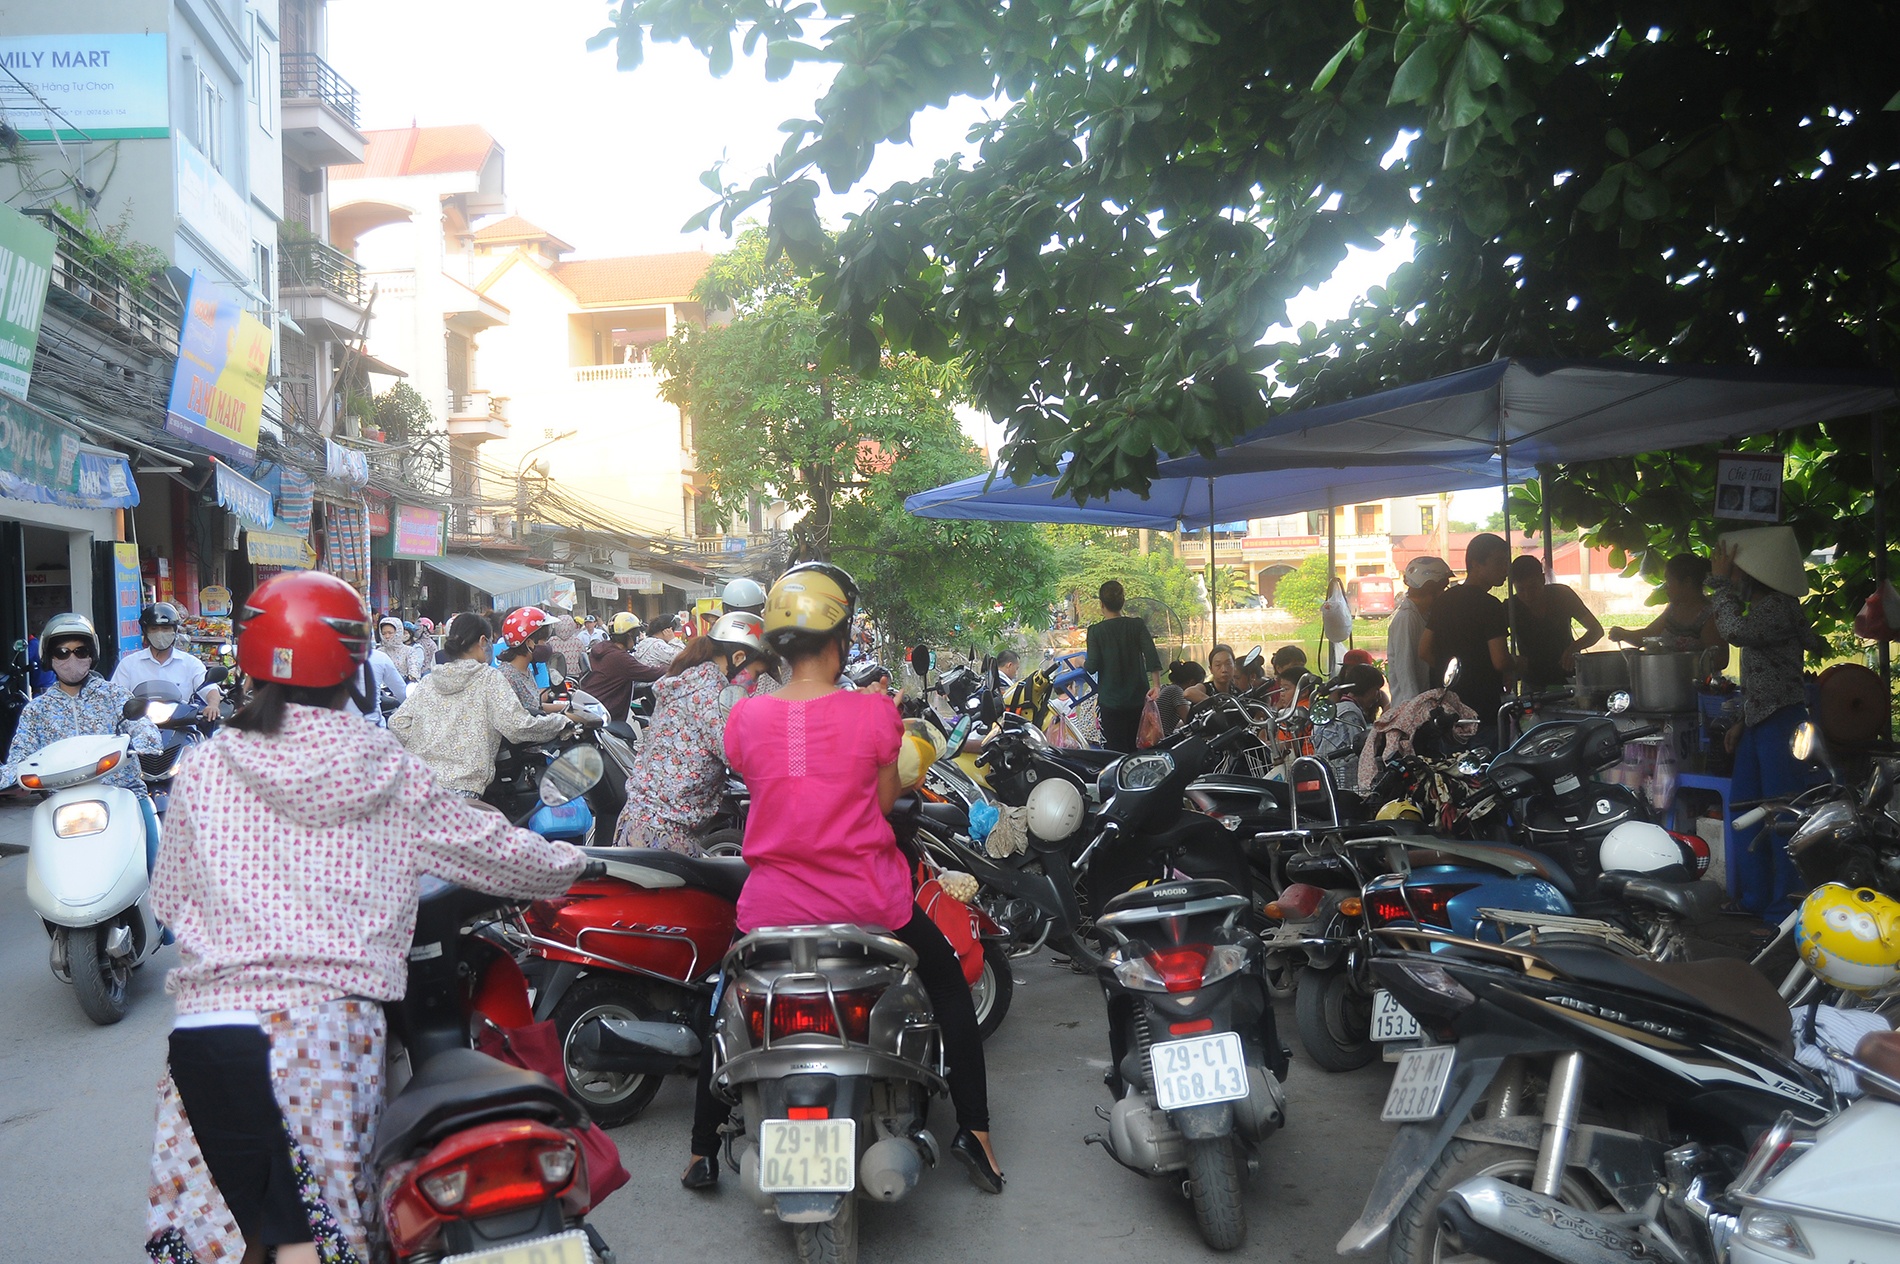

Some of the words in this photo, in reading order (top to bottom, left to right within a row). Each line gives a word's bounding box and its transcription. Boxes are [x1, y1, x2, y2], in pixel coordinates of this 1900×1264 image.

[52, 50, 110, 68] MART
[42, 82, 70, 92] Hàng
[86, 81, 114, 91] Chọn
[187, 374, 217, 420] FAMI
[214, 390, 246, 434] MART
[1727, 465, 1747, 481] Chè
[1749, 466, 1773, 482] Thái
[1153, 887, 1188, 898] PIAGGIO
[1164, 1039, 1228, 1074] 29-C1
[1401, 1052, 1446, 1083] 29-M1
[1162, 1066, 1242, 1104] 168.43
[1773, 1079, 1819, 1104] 125
[774, 1125, 840, 1154] 29-M1
[766, 1156, 848, 1186] 041.36
